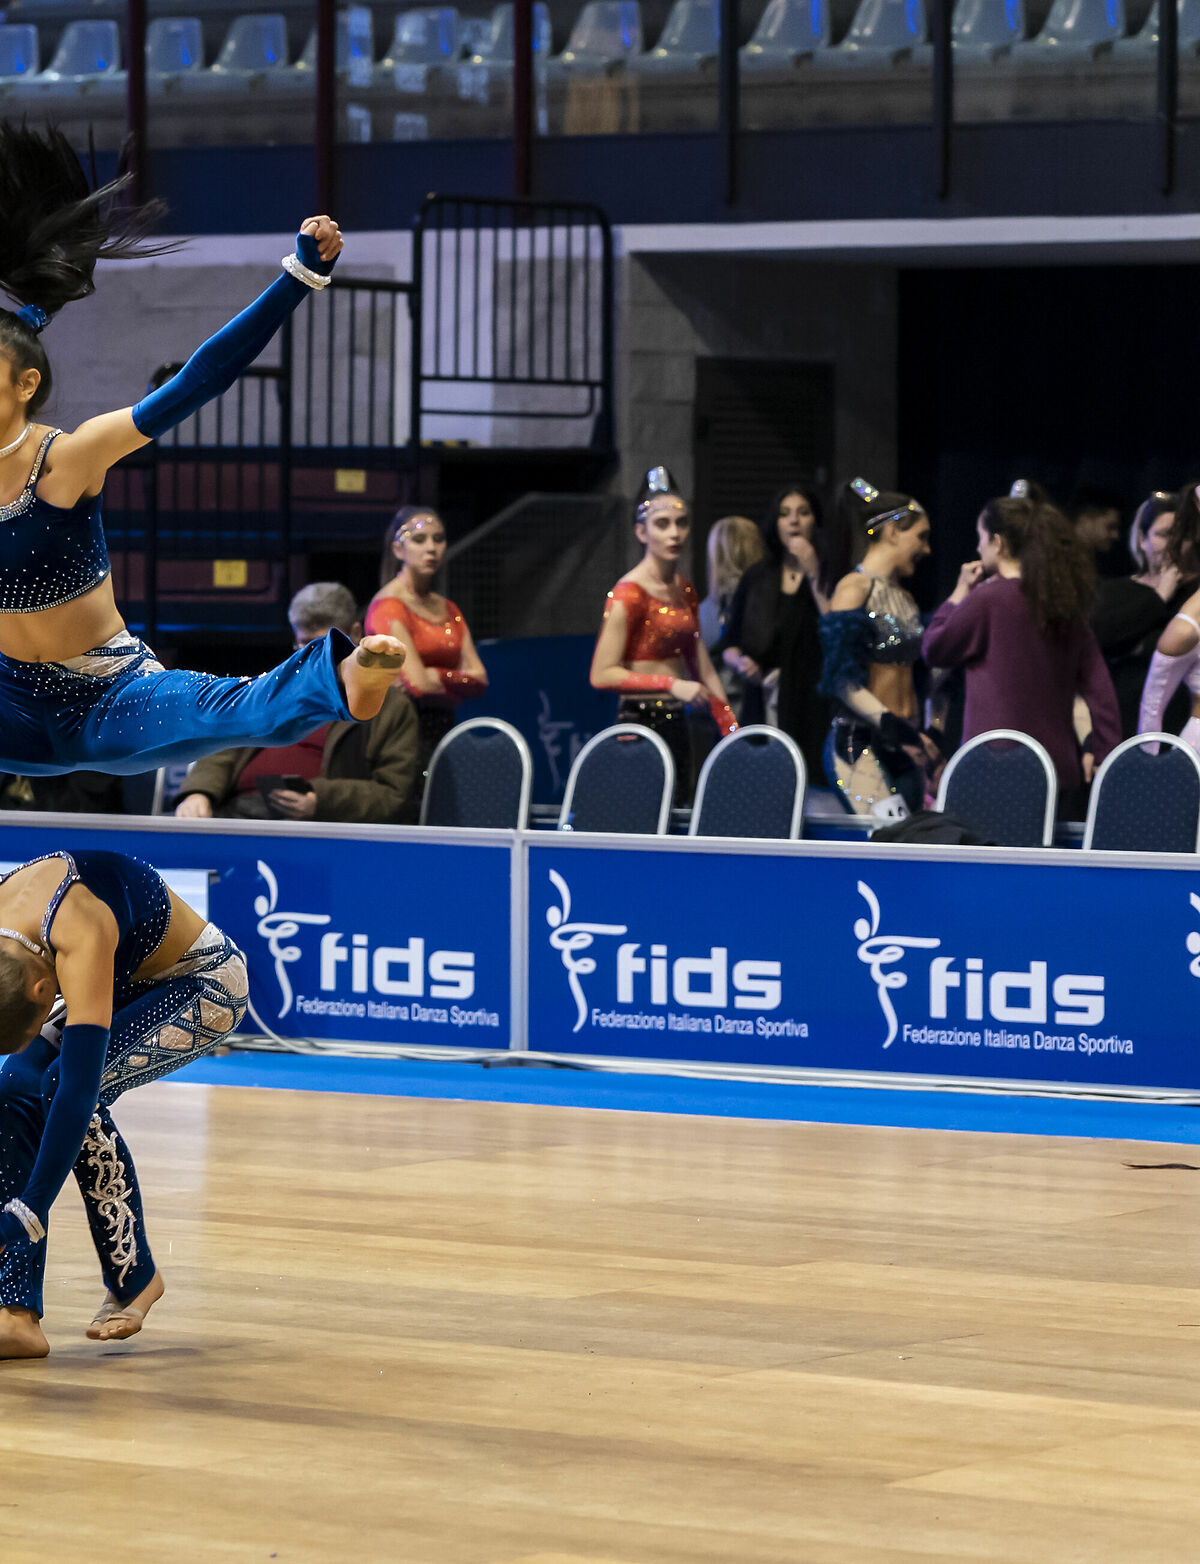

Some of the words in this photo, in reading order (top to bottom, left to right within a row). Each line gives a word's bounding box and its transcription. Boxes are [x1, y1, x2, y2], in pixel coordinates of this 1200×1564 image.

[320, 932, 475, 999] fids
[616, 943, 782, 1010] fids
[296, 995, 366, 1018] Federazione
[367, 1000, 409, 1021] Italiana
[411, 1003, 448, 1023] Danza
[450, 1006, 499, 1028] Sportiva
[929, 956, 1105, 1026] fids
[591, 1008, 666, 1030] Federazione
[668, 1012, 712, 1032] Italiana
[714, 1015, 753, 1035] Danza
[756, 1016, 808, 1039] Sportiva
[903, 1024, 981, 1046] Federazione
[984, 1028, 1030, 1049] Italiana
[1033, 1030, 1075, 1051] Danza
[1078, 1033, 1134, 1056] Sportiva
